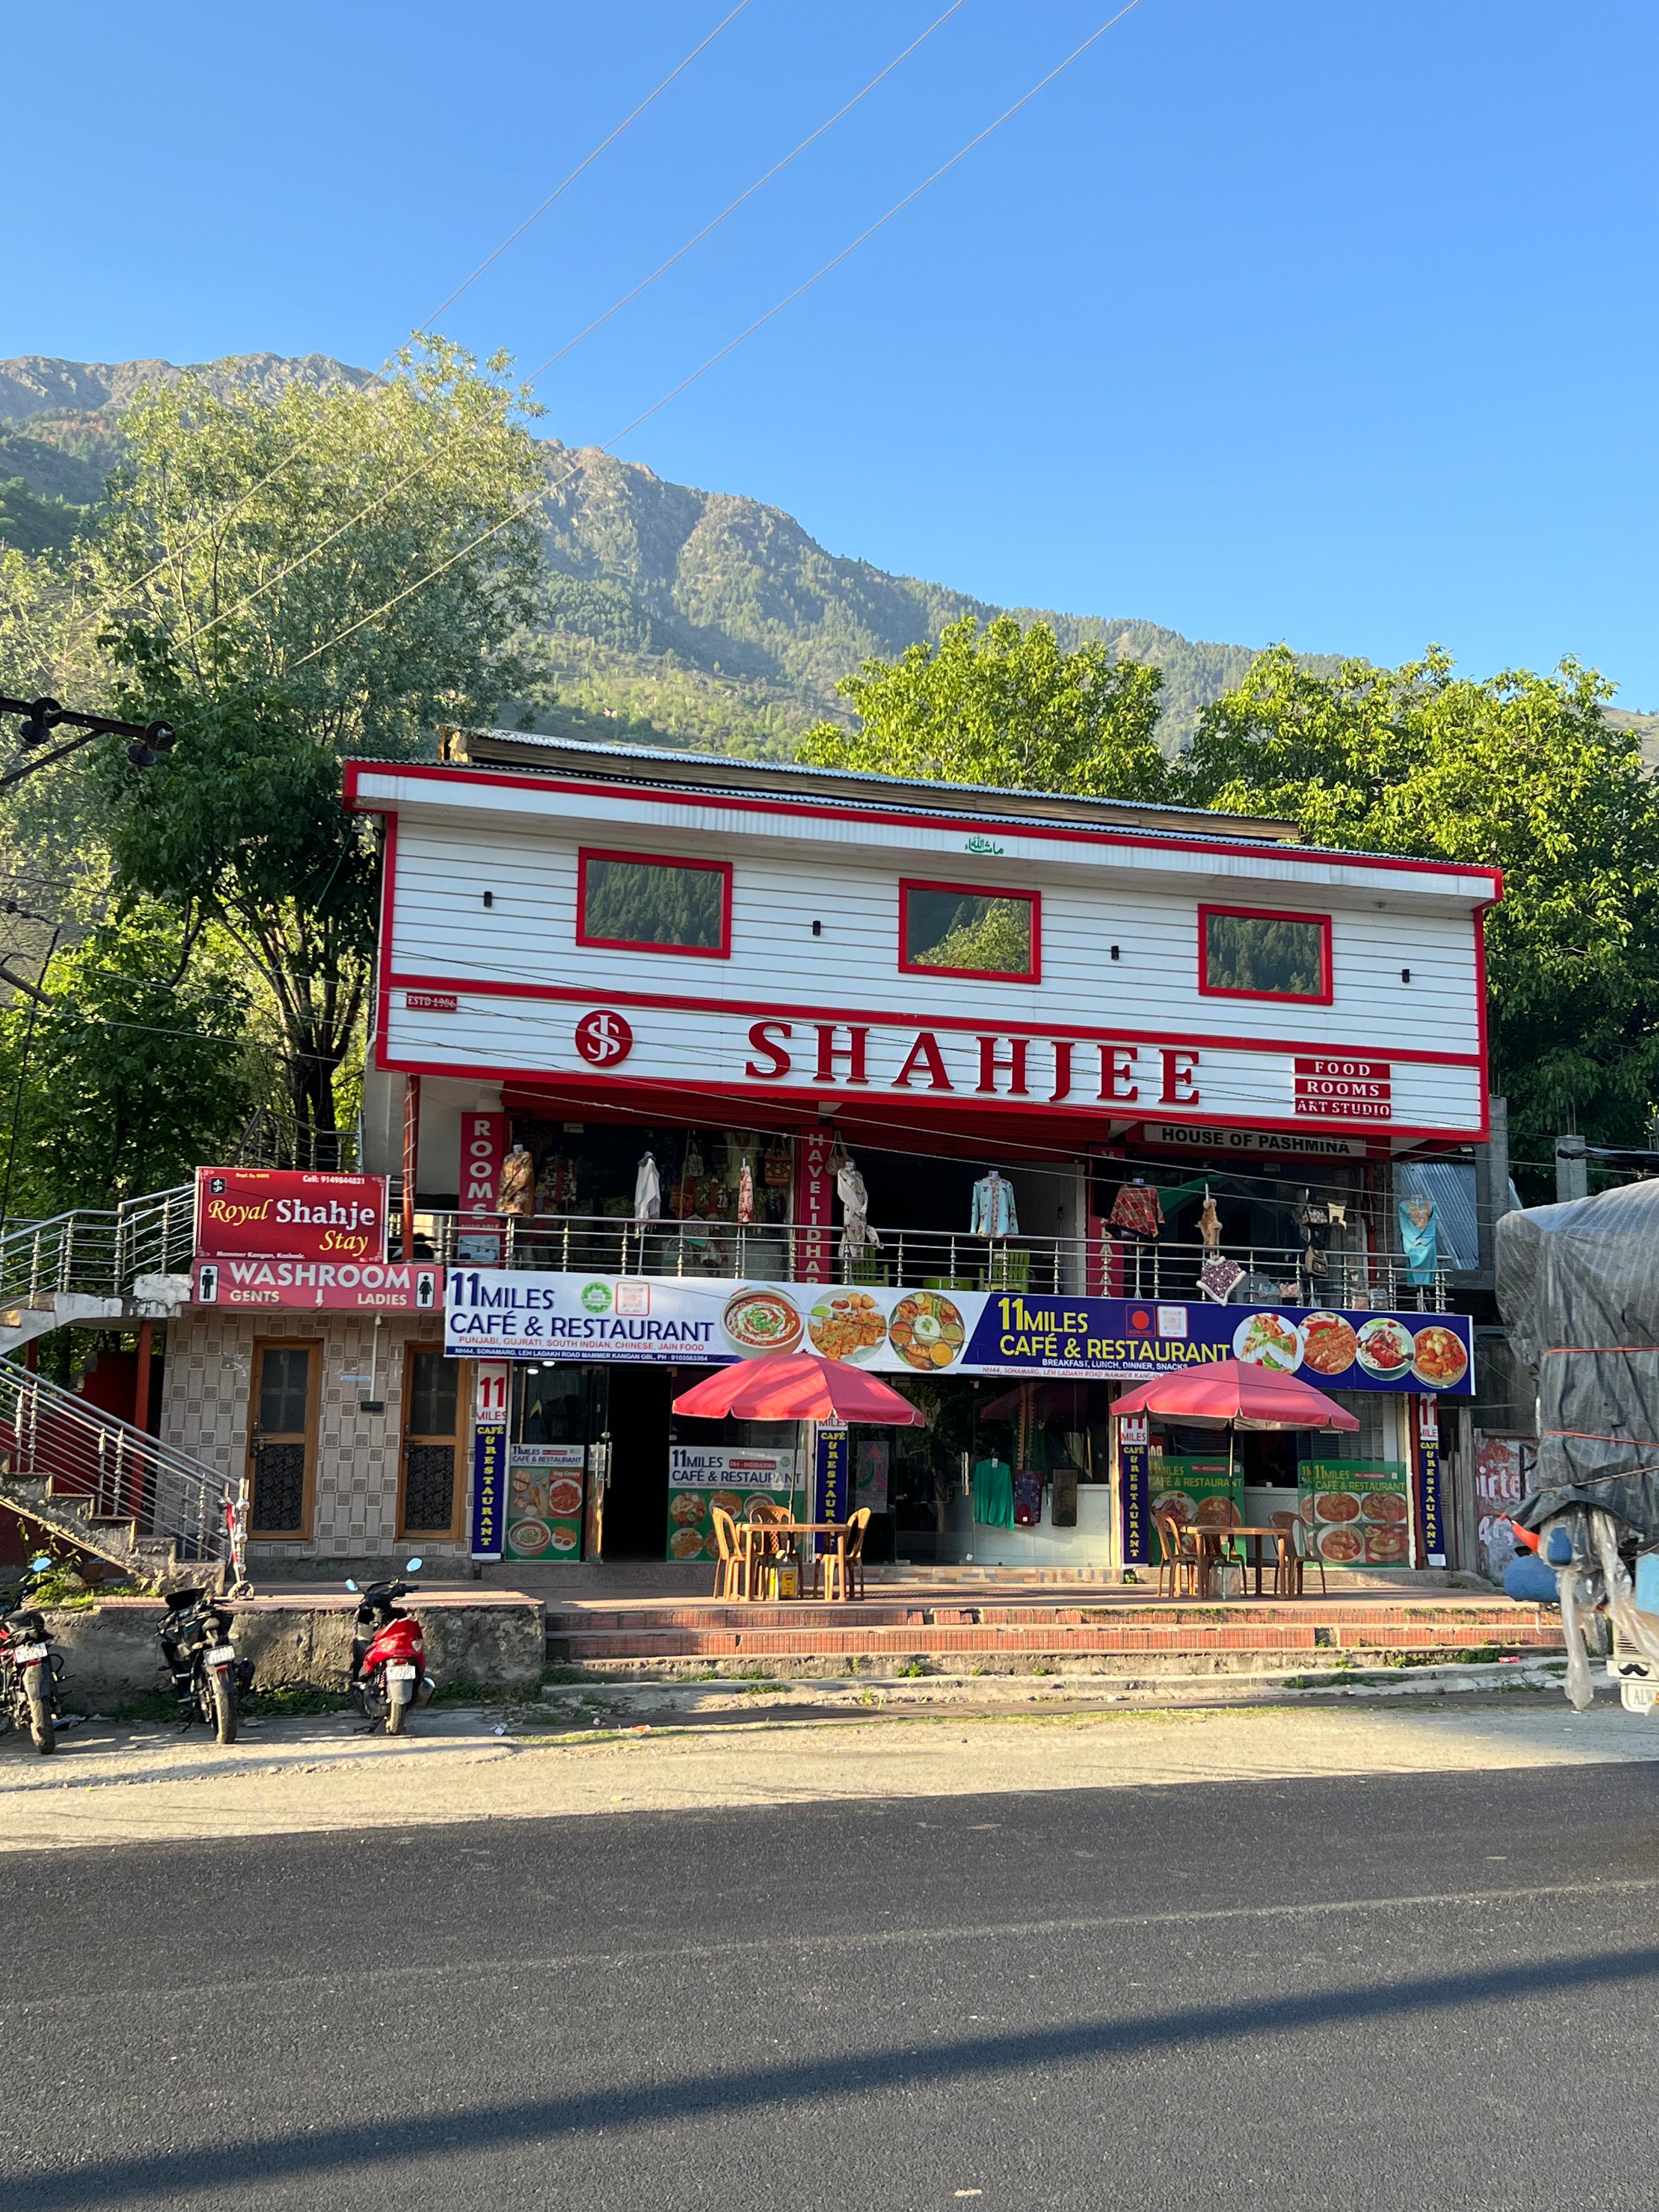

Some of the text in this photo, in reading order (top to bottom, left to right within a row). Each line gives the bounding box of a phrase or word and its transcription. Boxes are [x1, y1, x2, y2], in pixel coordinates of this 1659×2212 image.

[745, 1020, 1200, 1107] SHAHJEE
[1314, 1061, 1370, 1076] FOOD
[1307, 1081, 1379, 1097] ROOMS
[1297, 1100, 1390, 1116] ART STUDIO
[1162, 1127, 1351, 1154] HOUSE OF PASHMINA
[467, 1120, 493, 1220] ROOMS
[208, 1198, 376, 1231] Royal Shahje
[319, 1229, 369, 1257] Stay
[228, 1262, 411, 1289] WASHROOM
[229, 1289, 407, 1306] GENTS LADIES
[450, 1311, 715, 1342] CAFÉ & RESTAURANT
[459, 1336, 501, 1346] PUNJABI,
[504, 1338, 545, 1347] GUJRATI,
[580, 1341, 612, 1350] INDIAN,
[615, 1341, 656, 1351] CHINESE,
[658, 1342, 678, 1351] JAIN
[999, 1333, 1231, 1363] CAFÉ & RESTAURANT
[480, 1376, 506, 1408] 11
[476, 1410, 506, 1420] MILES
[477, 1425, 504, 1435] CAFÉ
[821, 1431, 845, 1440] CAFÉ
[1121, 1432, 1146, 1442] MILES
[1124, 1446, 1144, 1454] CAFÉ
[672, 1468, 705, 1481] CAFÉ
[708, 1471, 716, 1481] &
[1316, 1480, 1405, 1491] CAFÉ & RESTAURANT
[1476, 1465, 1532, 1498] irtel
[481, 1446, 497, 1546] RESTAURANT
[1426, 1459, 1436, 1548] RESTAURANT
[1129, 1465, 1140, 1557] RESTAURANT
